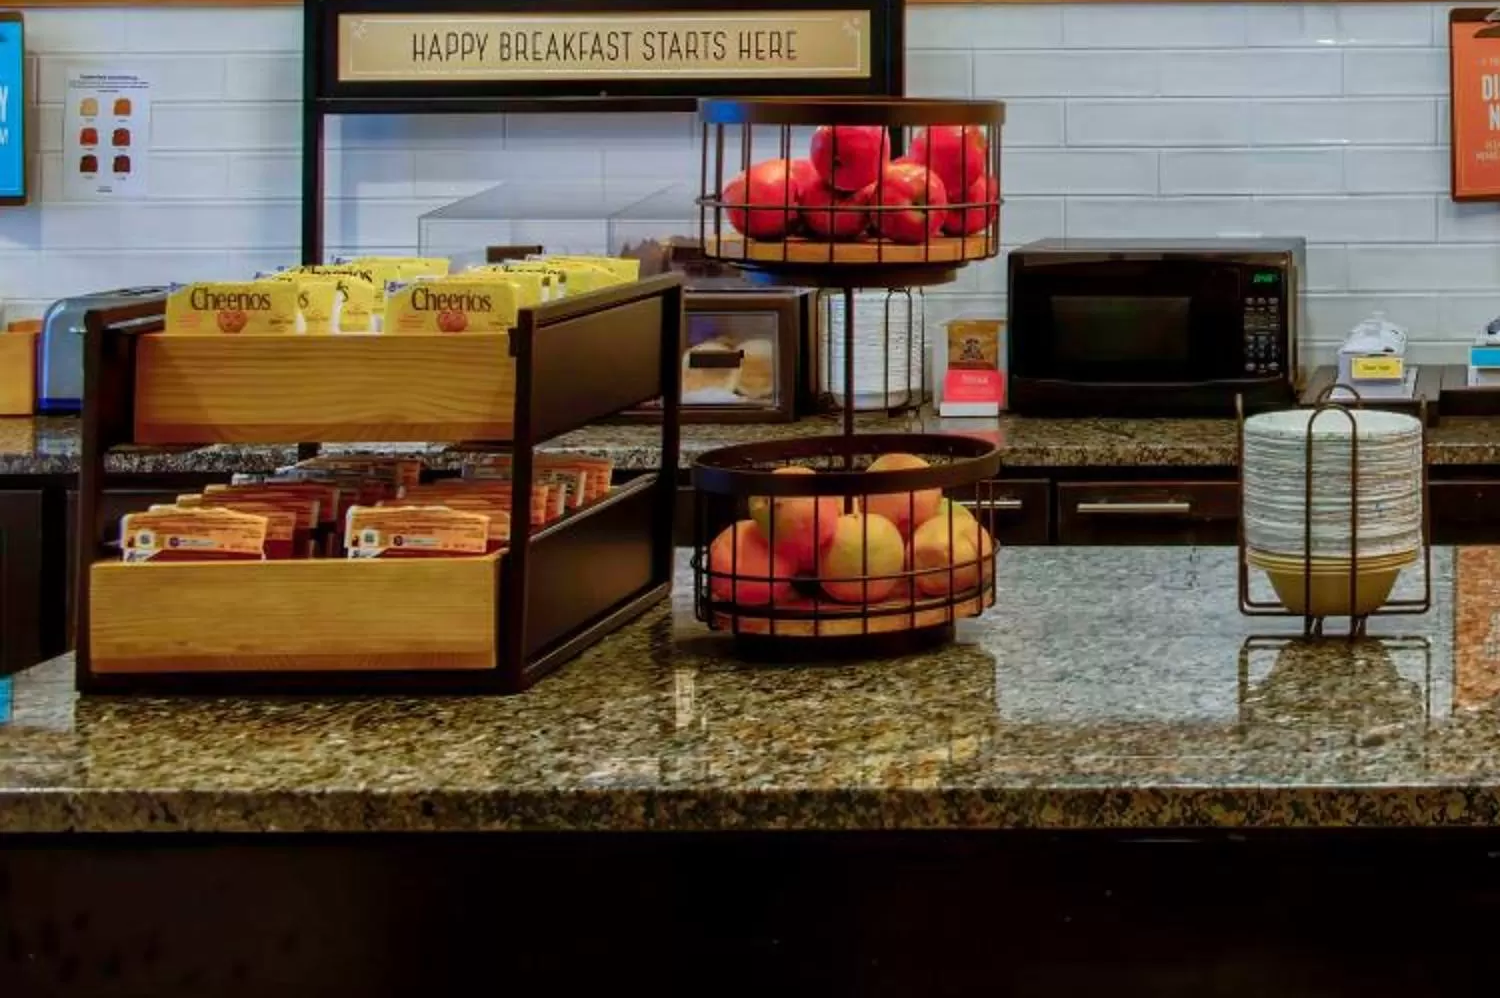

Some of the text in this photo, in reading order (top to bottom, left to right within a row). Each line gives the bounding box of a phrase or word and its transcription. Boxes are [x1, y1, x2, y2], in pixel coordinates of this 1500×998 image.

[412, 31, 798, 62] HAPPY BREAKFAST STARTS HERE
[190, 286, 272, 311] Cheerios
[411, 287, 493, 313] Cheerios
